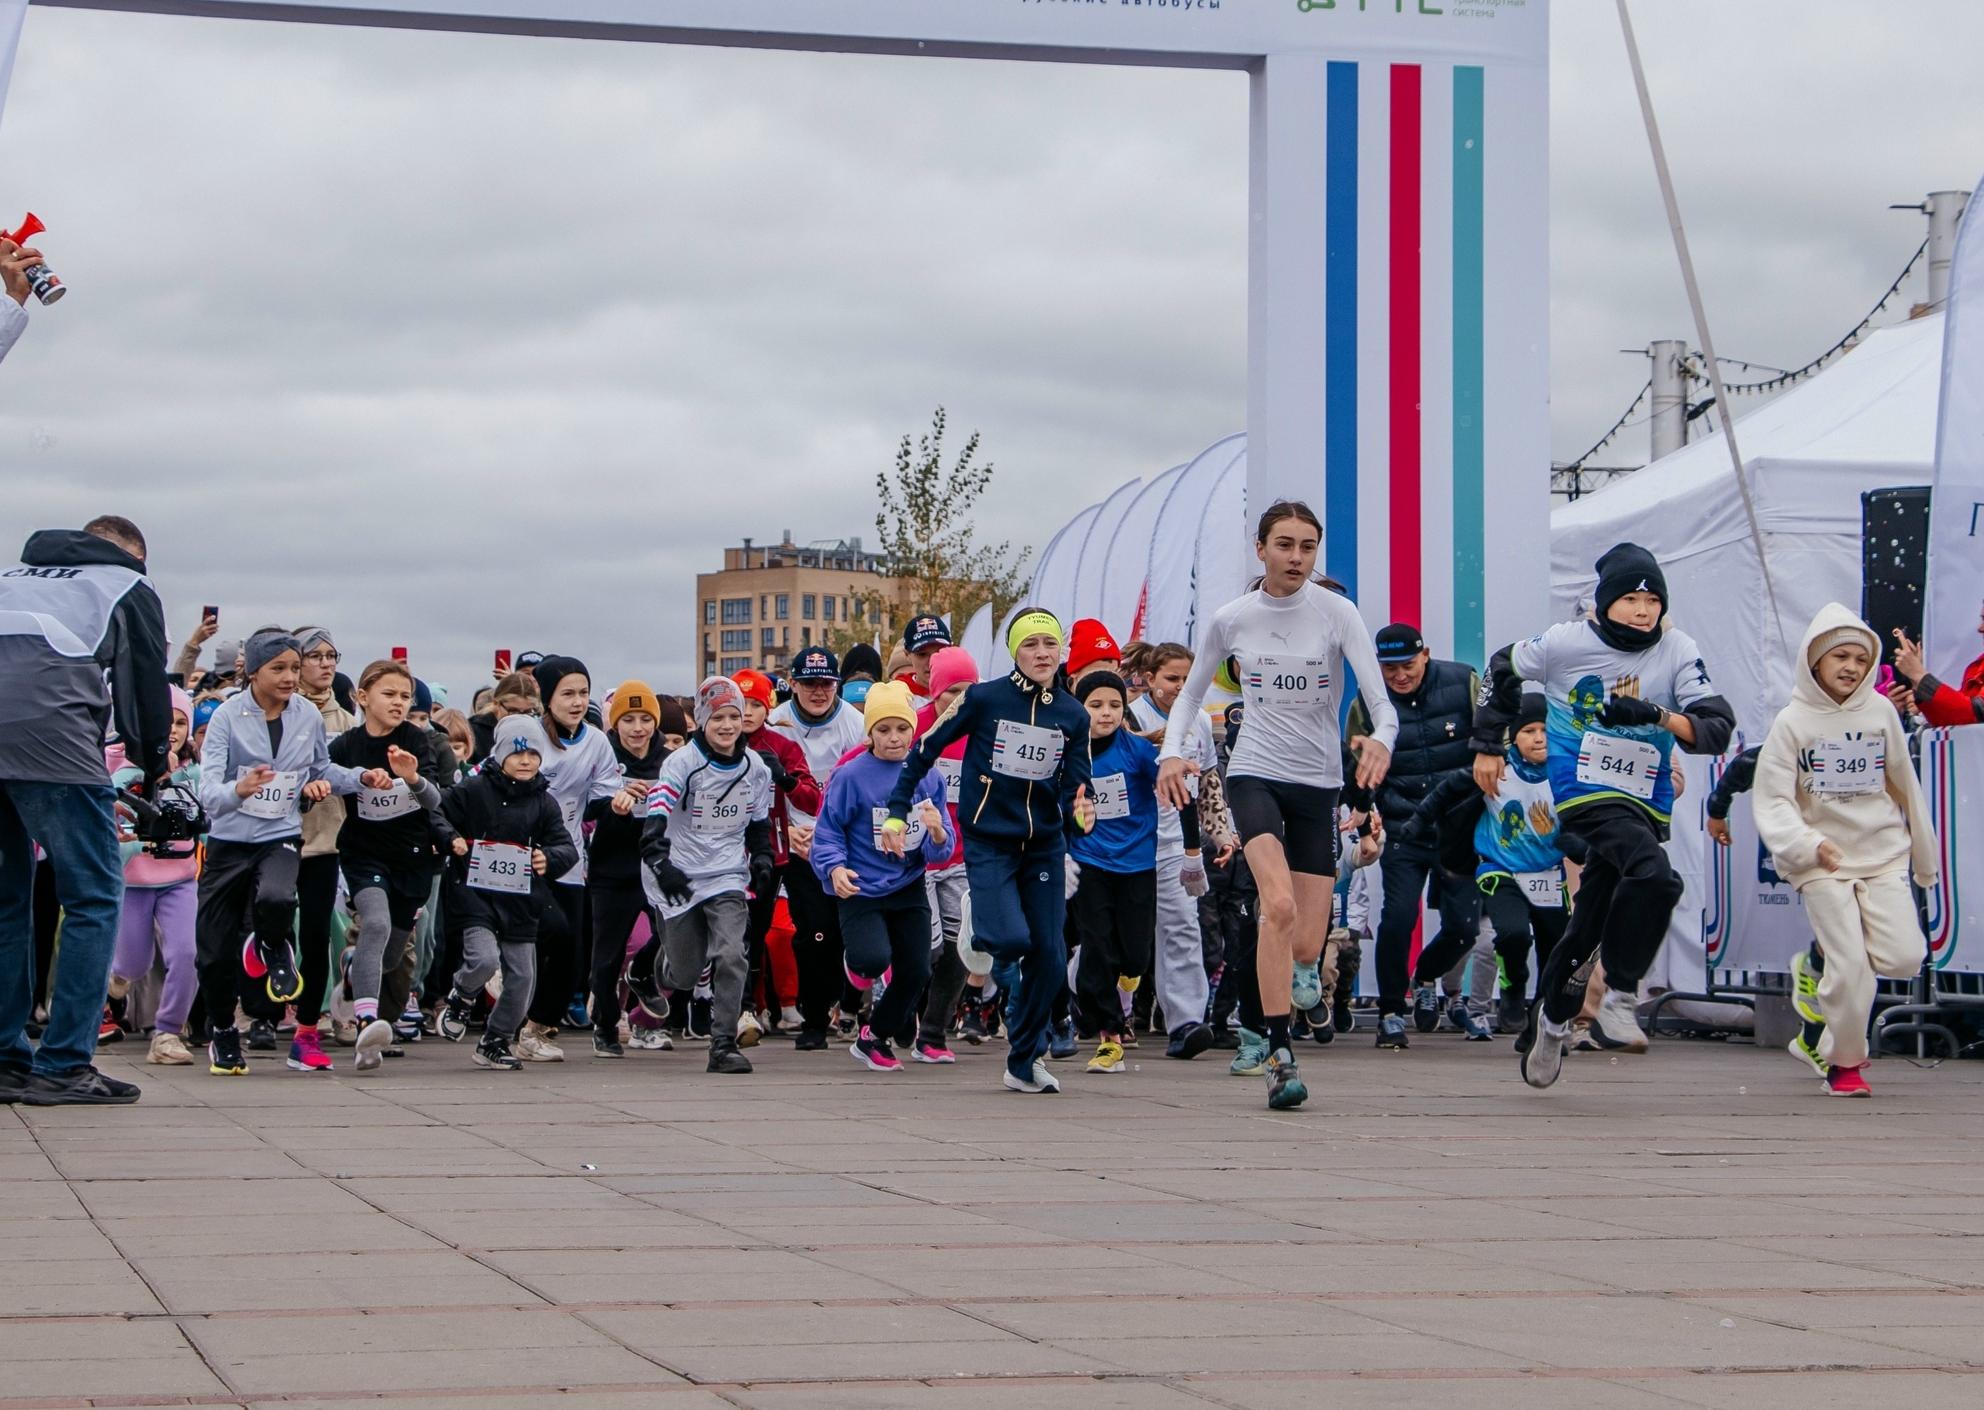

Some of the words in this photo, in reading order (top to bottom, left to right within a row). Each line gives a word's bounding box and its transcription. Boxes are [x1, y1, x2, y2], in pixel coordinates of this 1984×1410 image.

[1121, 0, 1220, 10] автобусы
[1452, 8, 1495, 18] система
[2, 567, 84, 579] СМИ
[1272, 674, 1307, 691] 400
[1016, 743, 1047, 762] 415
[1600, 755, 1635, 776] 544
[1835, 757, 1867, 774] 349
[254, 786, 282, 802] 310
[370, 794, 399, 808] 467
[711, 804, 738, 818] 369
[905, 820, 920, 835] 25
[488, 859, 517, 876] 433
[1528, 879, 1550, 892] 371
[1758, 893, 1790, 905] ТЮМЕНЬ
